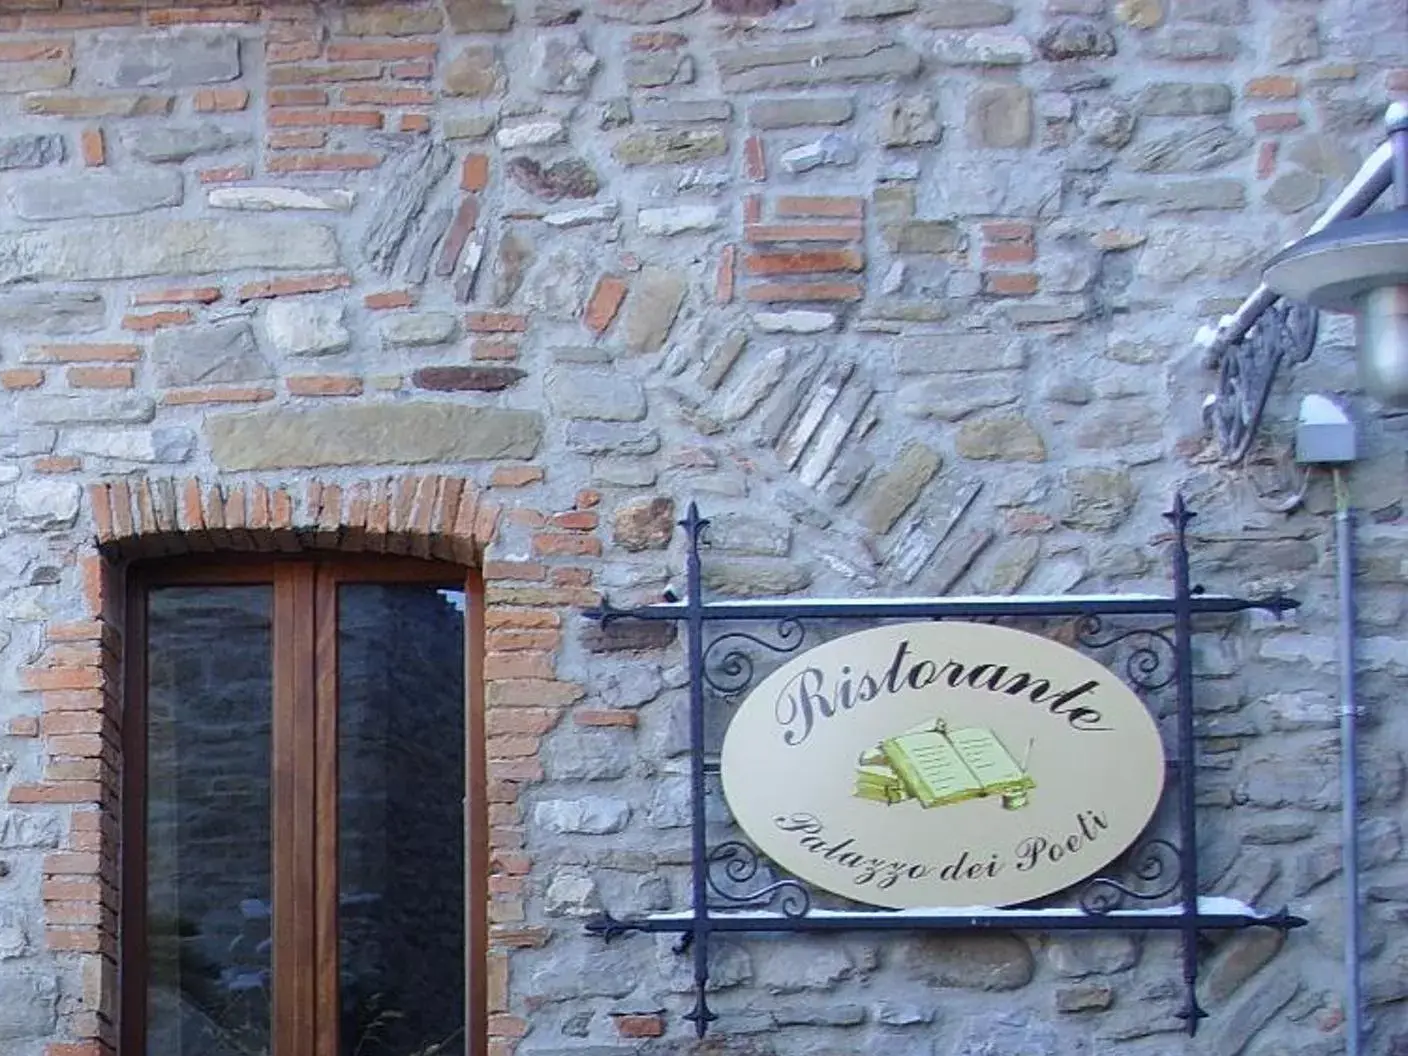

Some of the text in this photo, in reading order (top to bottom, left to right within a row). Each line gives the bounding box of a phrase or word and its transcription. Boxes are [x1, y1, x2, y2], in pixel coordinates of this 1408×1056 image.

[776, 641, 1115, 746] Ristorante
[775, 810, 1108, 889] Palazzo dei Poeti
